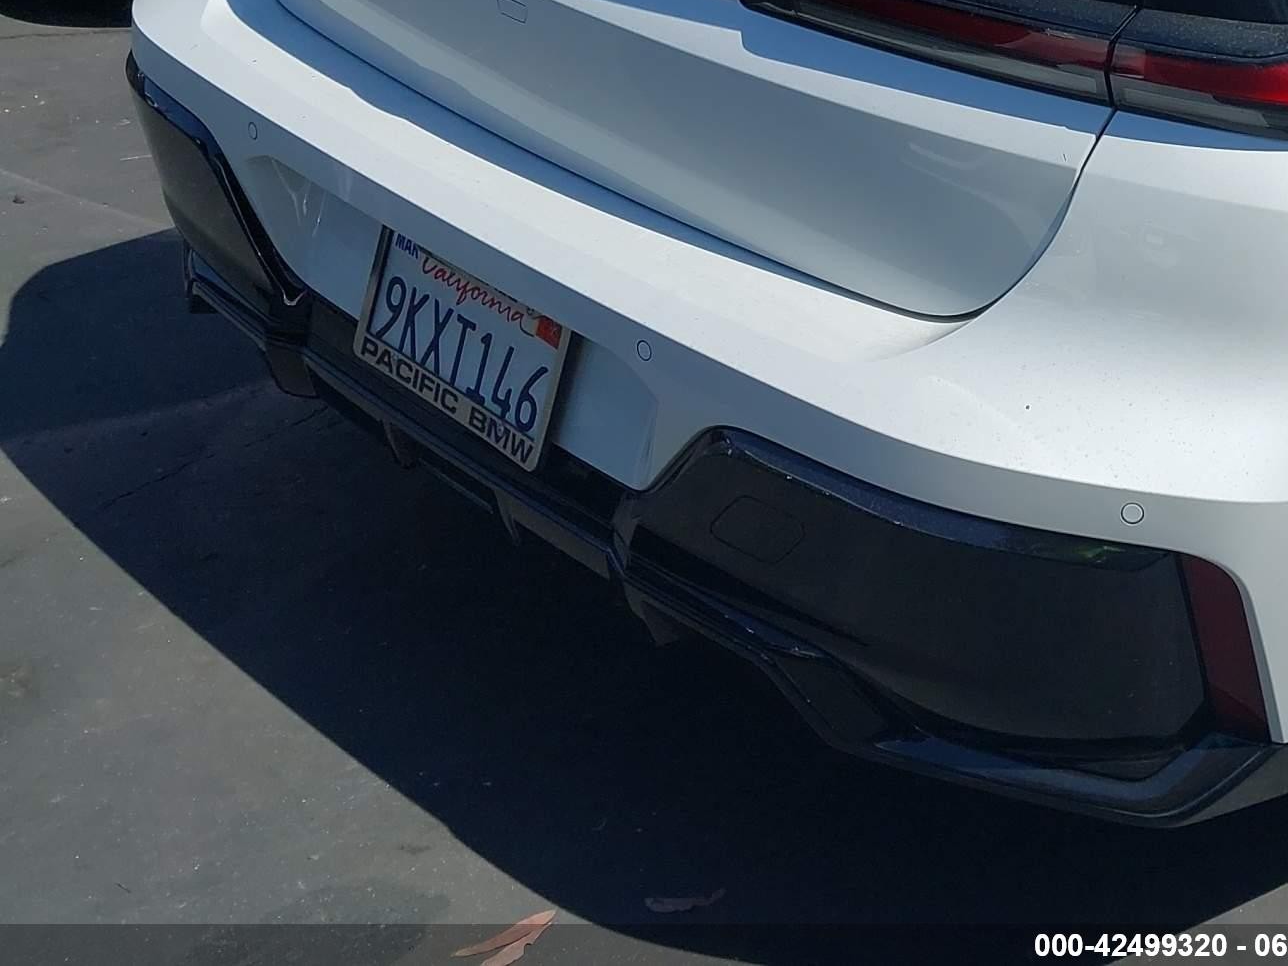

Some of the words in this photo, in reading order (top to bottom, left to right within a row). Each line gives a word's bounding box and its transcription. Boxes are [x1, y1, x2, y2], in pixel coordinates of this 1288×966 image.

[360, 336, 457, 415] PACIFIC
[468, 406, 535, 465] BMW
[366, 276, 549, 434] 9KXT146
